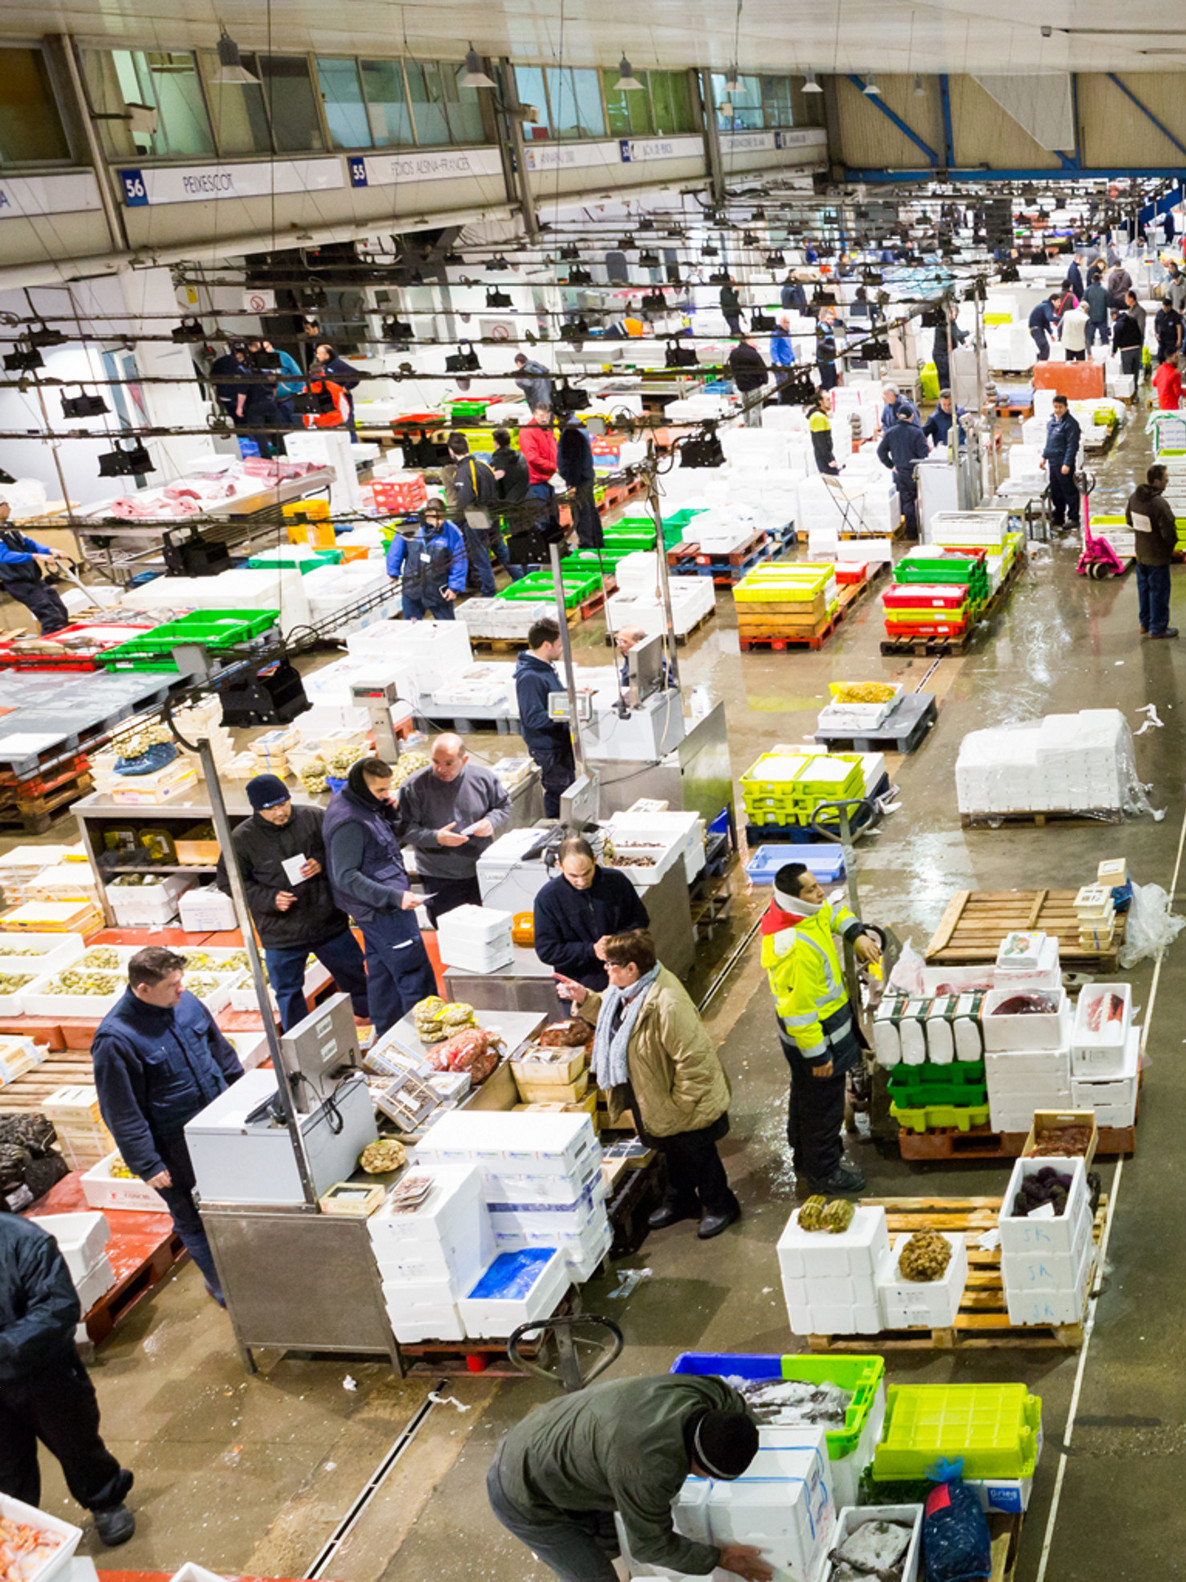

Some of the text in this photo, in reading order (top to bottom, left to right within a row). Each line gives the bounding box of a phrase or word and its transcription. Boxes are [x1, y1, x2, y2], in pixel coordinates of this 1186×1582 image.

[353, 164, 366, 180] 55
[125, 178, 145, 198] 56
[183, 172, 235, 194] PEIXESCOT
